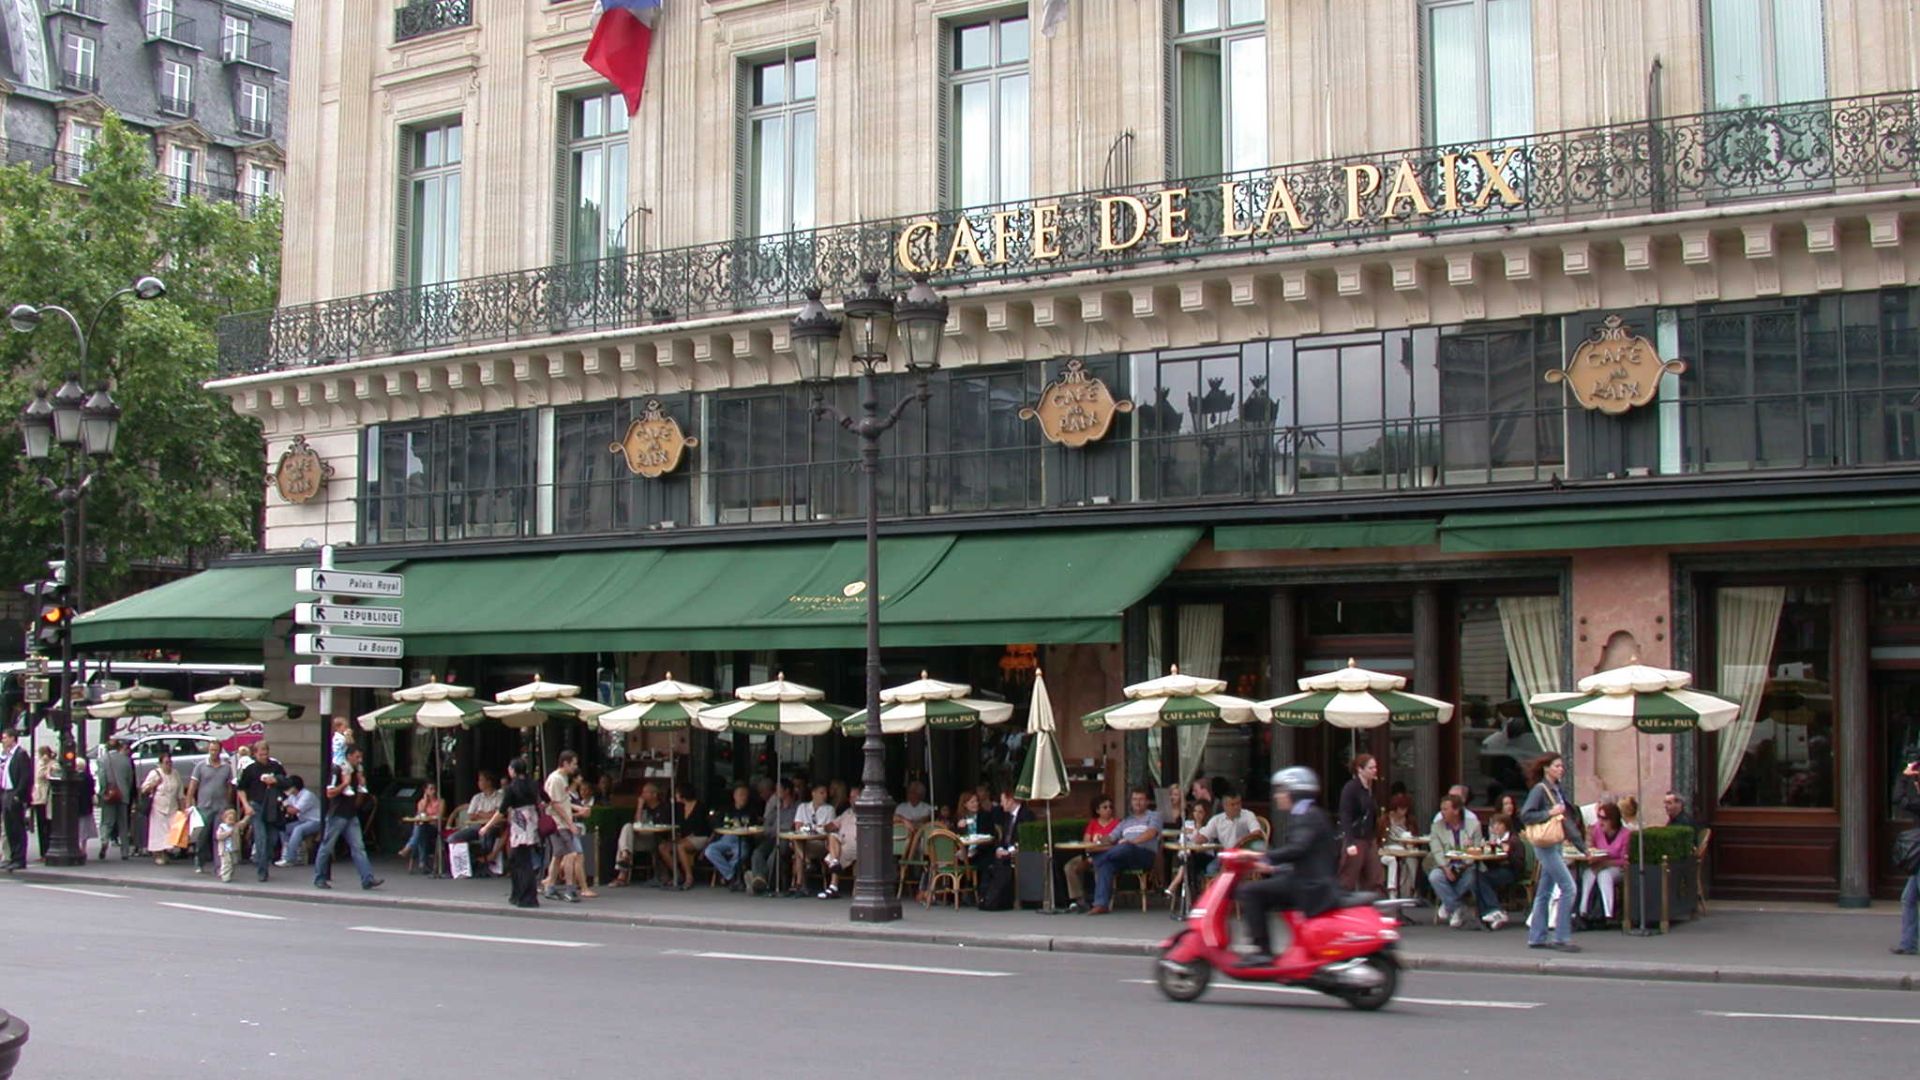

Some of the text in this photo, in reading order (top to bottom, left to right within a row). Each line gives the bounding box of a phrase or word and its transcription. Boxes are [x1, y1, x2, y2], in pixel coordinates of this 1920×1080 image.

[899, 147, 1525, 273] CAFE DE LA PAIX
[349, 578, 400, 592] Palais Royal
[343, 610, 399, 622] RÉPUBLIQUE
[371, 643, 398, 652] Bourse
